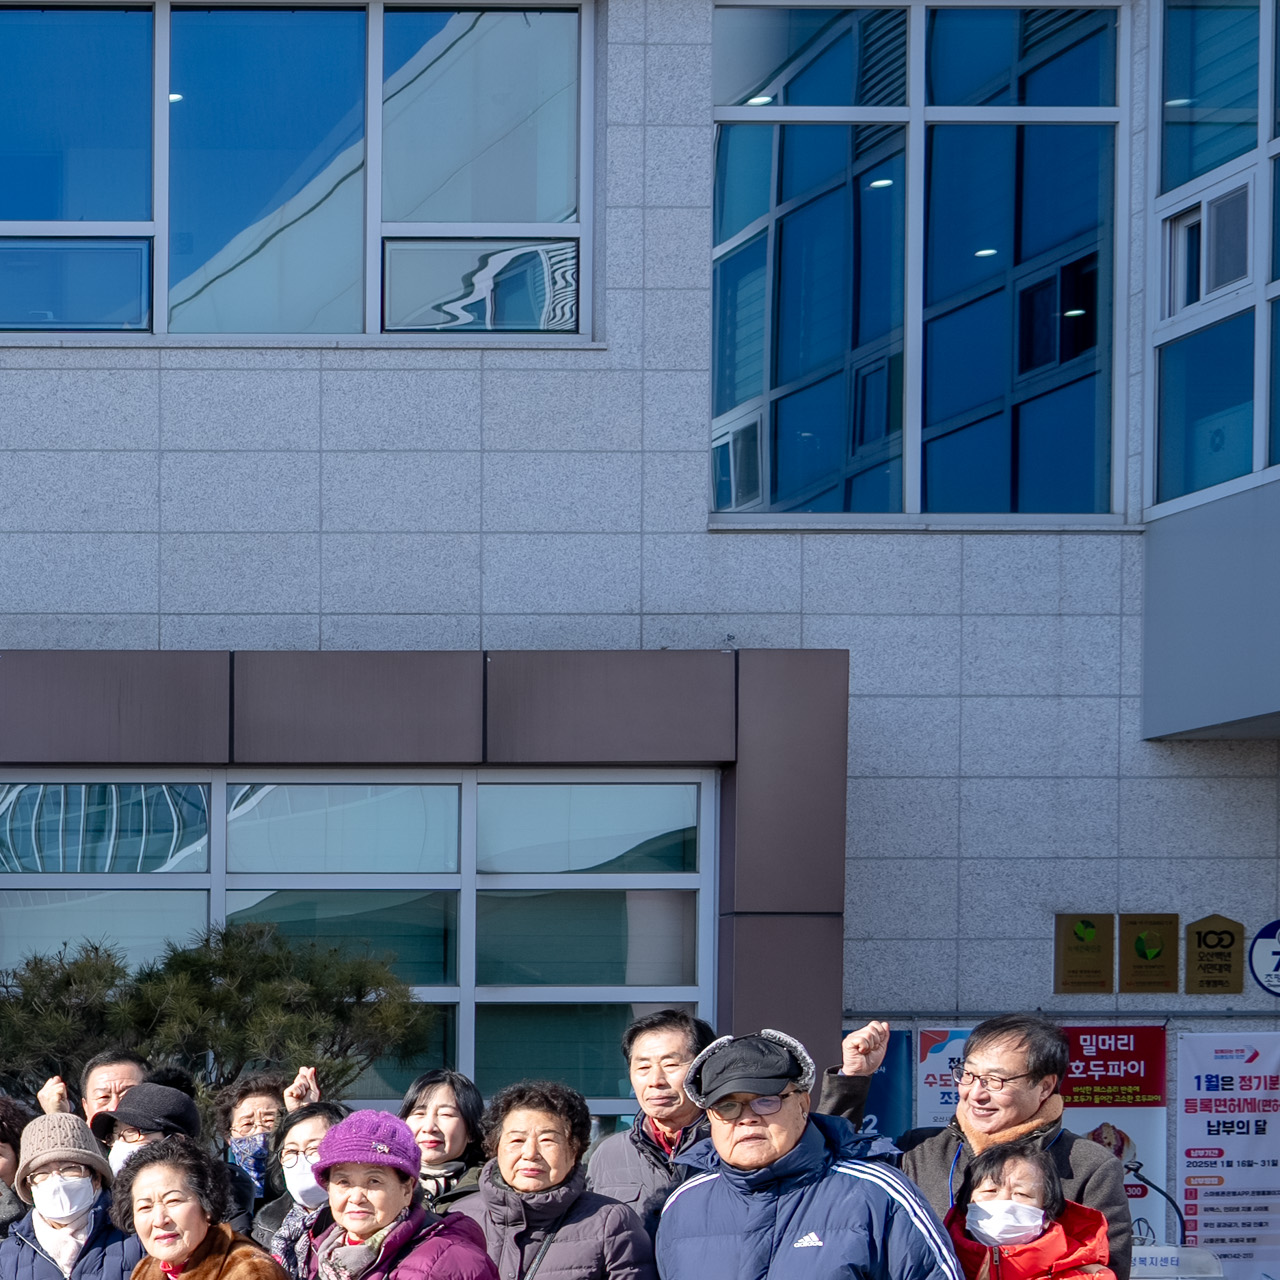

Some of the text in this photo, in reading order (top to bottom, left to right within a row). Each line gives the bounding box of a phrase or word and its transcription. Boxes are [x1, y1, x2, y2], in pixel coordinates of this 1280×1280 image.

[1195, 930, 1235, 949] 100
[1080, 1034, 1134, 1056] 밀머리
[1068, 1060, 1144, 1080] 호두파이
[1194, 1073, 1280, 1092] 1월은 정기분
[1207, 1119, 1268, 1136] 납부의 달
[1186, 1160, 1218, 1168] 2025년
[1220, 1160, 1234, 1168] 1월
